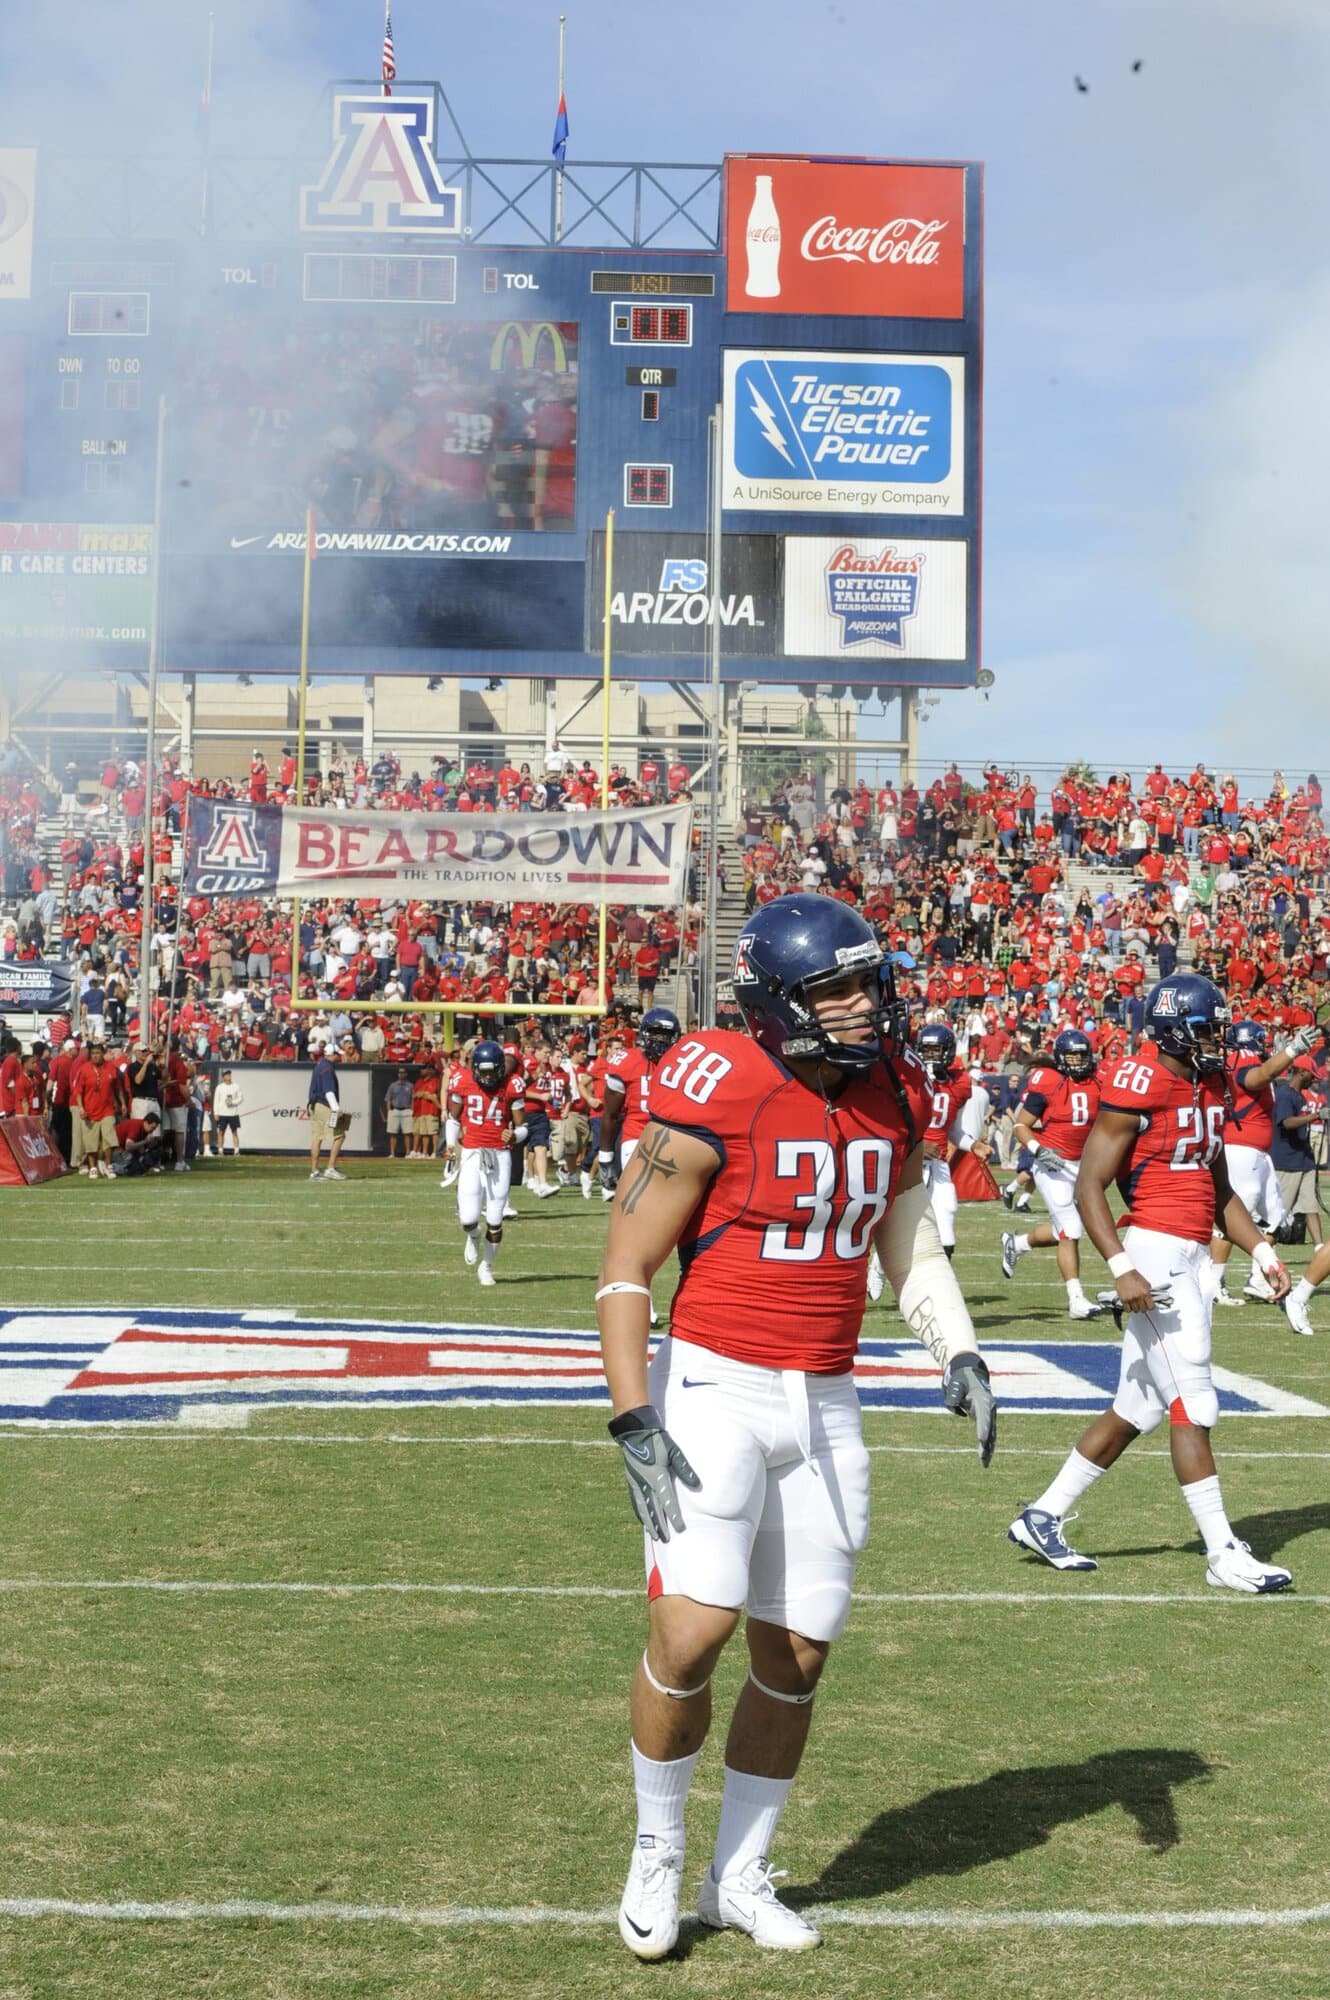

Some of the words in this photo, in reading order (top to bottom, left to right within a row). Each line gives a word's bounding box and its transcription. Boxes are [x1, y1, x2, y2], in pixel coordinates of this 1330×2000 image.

[801, 216, 948, 264] Coca-Cola
[222, 268, 256, 284] TOL
[504, 273, 539, 290] TOL
[632, 275, 671, 293] WSU
[59, 358, 83, 373] DWN
[107, 358, 120, 373] TO
[124, 359, 140, 373] GO
[640, 368, 662, 385] QTR
[790, 375, 902, 407] Tucson
[800, 405, 931, 437] Electric
[82, 440, 107, 455] BALL
[813, 435, 930, 465] Power
[733, 486, 744, 499] A
[748, 487, 823, 501] UniSource
[827, 489, 878, 505] Energy
[881, 489, 950, 506] Company
[20, 555, 65, 573] CARE
[72, 556, 148, 574] CENTERS
[829, 546, 922, 573] Bashas'
[659, 559, 708, 593] FS
[834, 578, 912, 591] OFFICIAL
[834, 591, 912, 604] TAILGATE
[834, 603, 911, 612] HEADQUARTERS
[602, 592, 756, 626] ARIZONA
[847, 621, 898, 631] ARIZONA
[295, 822, 473, 869] BEAR
[471, 821, 676, 868] DOWN
[403, 870, 428, 881] THE
[435, 870, 516, 883] TRADITION
[522, 872, 562, 883] LIVES
[660, 1041, 733, 1104] 38
[1112, 1061, 1154, 1095] 26
[272, 1106, 312, 1121] veriz
[467, 1094, 504, 1127] 24
[1071, 1092, 1089, 1126] 8
[1169, 1106, 1227, 1171] 26
[760, 1139, 893, 1262] 38
